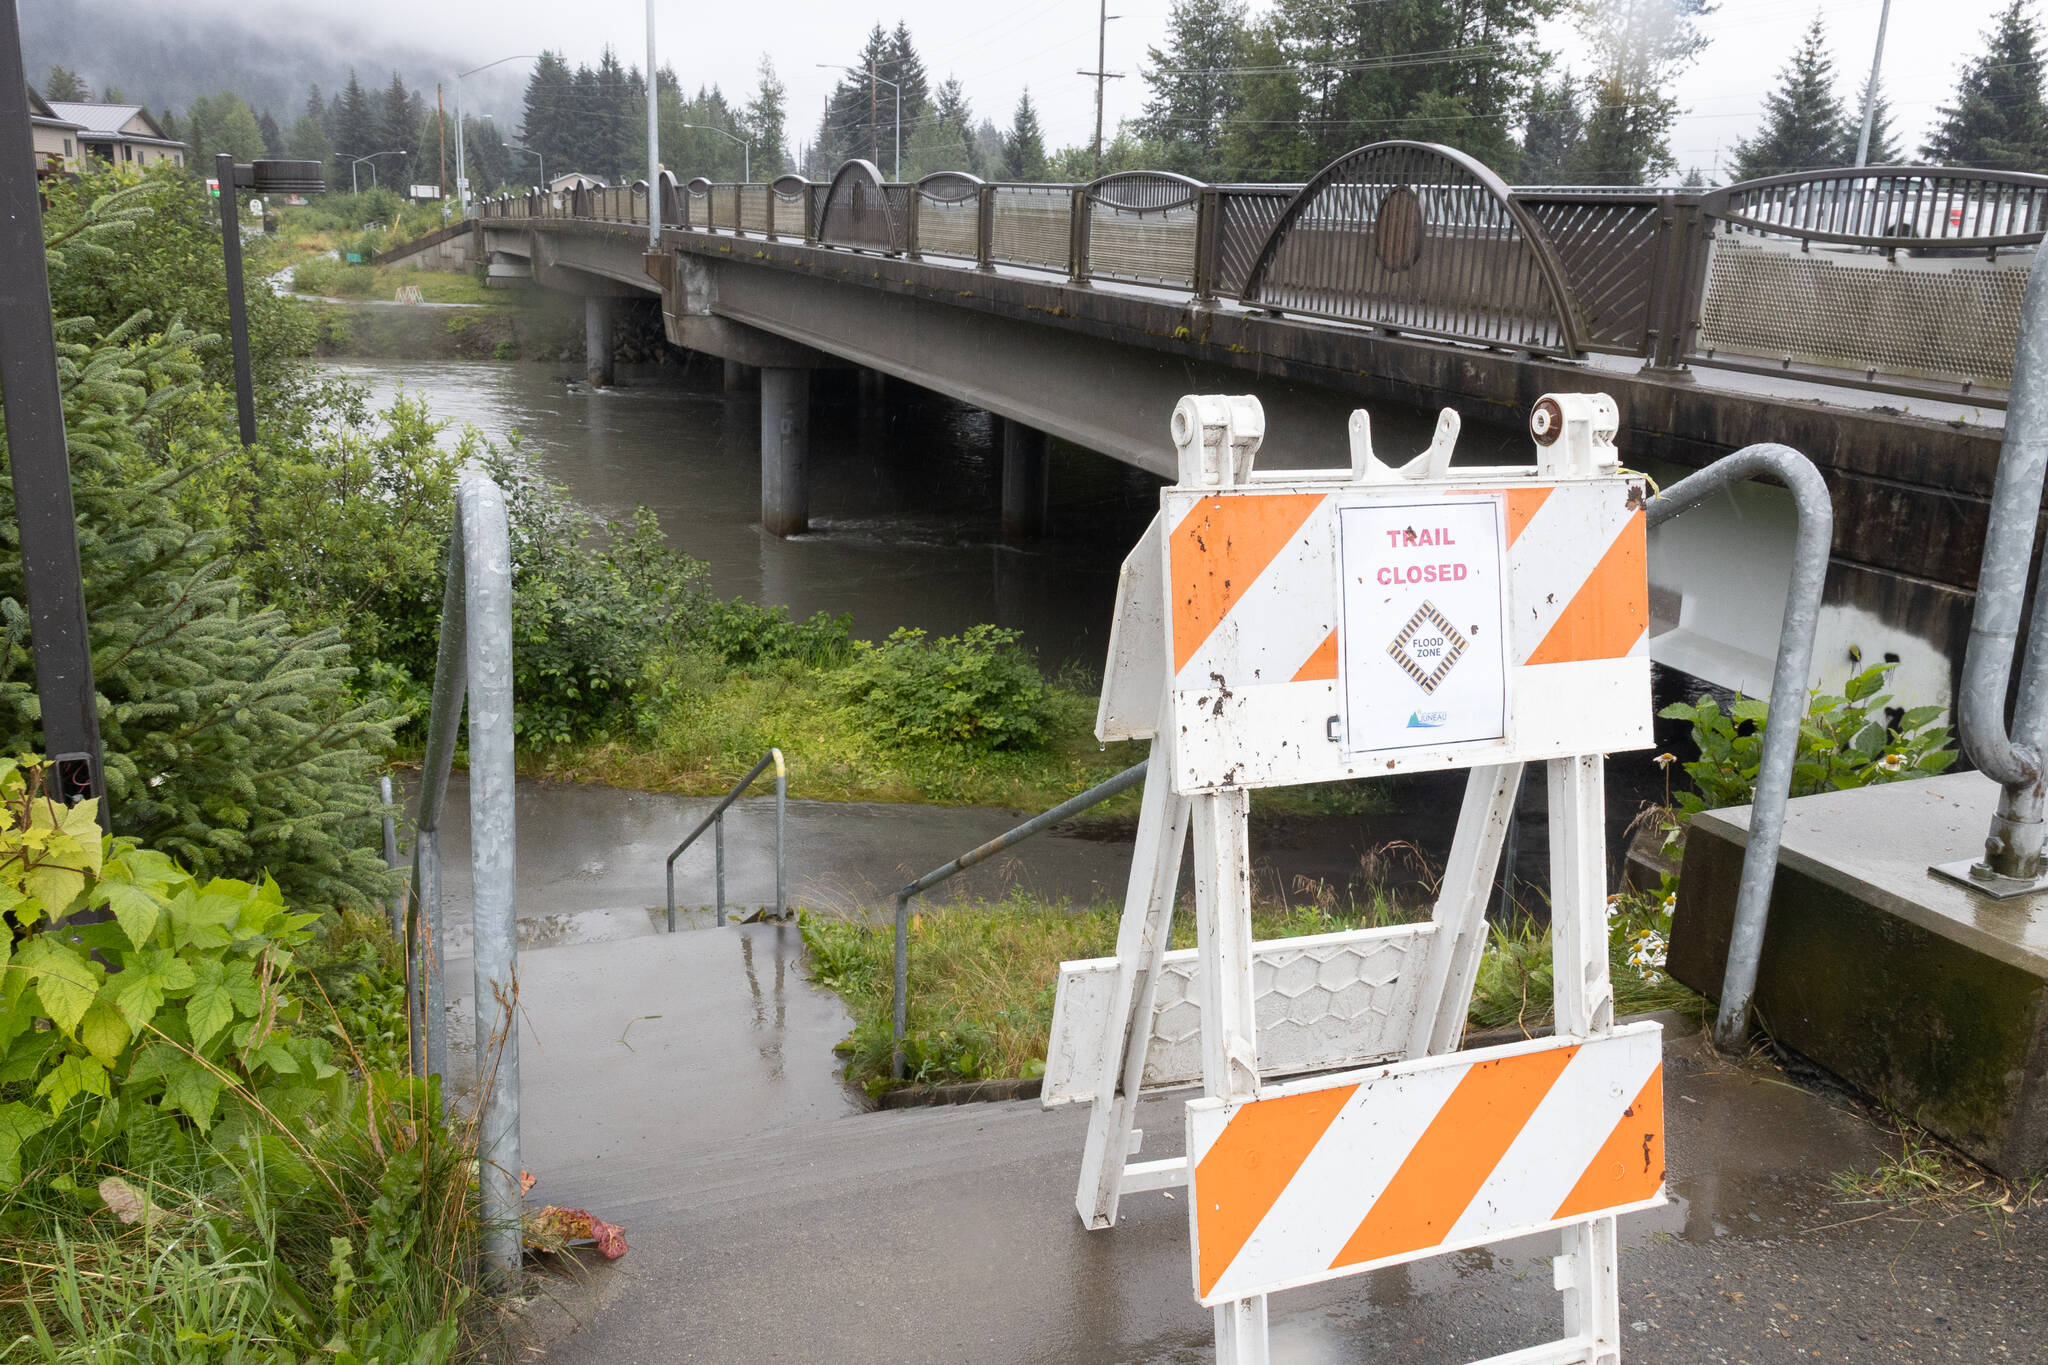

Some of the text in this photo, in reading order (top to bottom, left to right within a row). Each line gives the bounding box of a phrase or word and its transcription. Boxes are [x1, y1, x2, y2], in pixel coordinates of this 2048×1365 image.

[1387, 528, 1455, 548] TRAIL
[1377, 563, 1467, 585] CLOSED
[1413, 637, 1444, 648] FLOOD
[1417, 648, 1441, 658] ZONE
